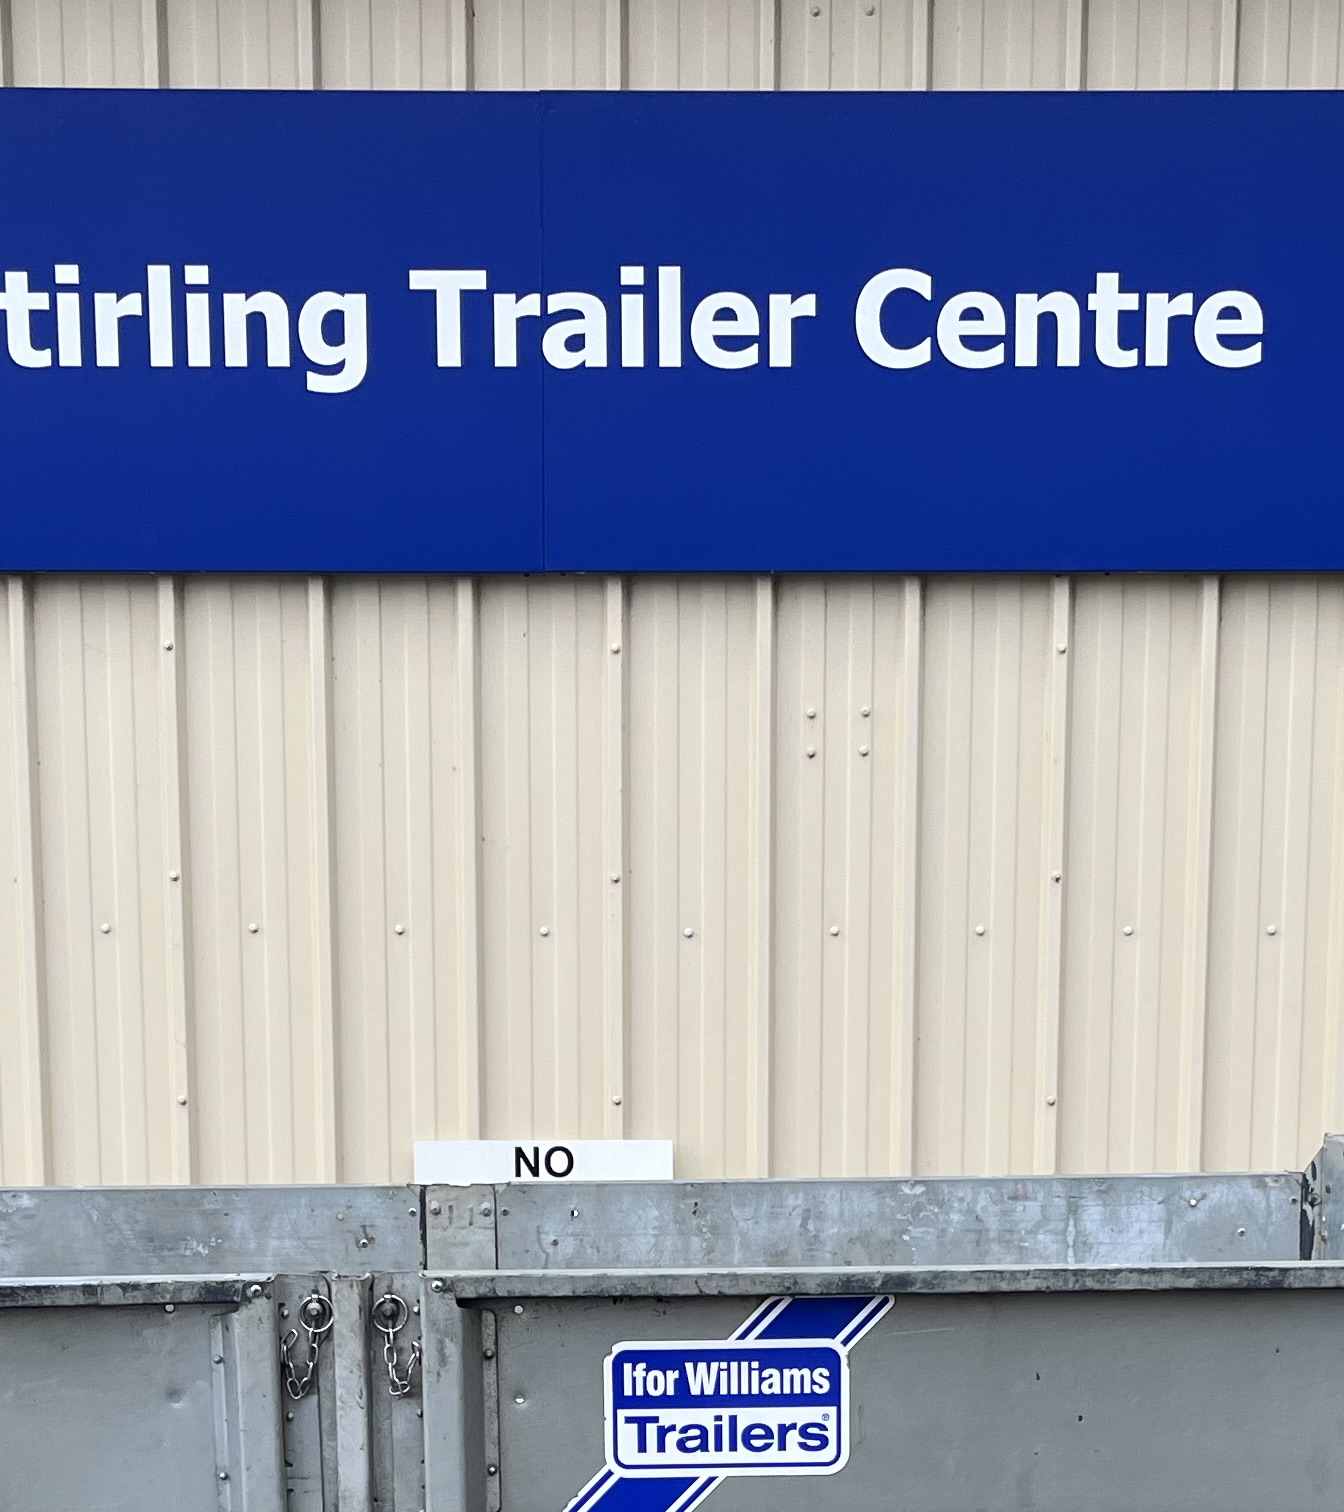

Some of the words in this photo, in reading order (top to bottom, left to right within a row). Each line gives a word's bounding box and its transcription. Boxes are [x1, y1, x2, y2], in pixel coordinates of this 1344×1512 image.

[408, 265, 817, 370] Trailer
[855, 267, 1265, 370] Centre
[514, 1145, 575, 1178] NO
[622, 1361, 680, 1397] Ifor
[684, 1360, 831, 1396] Williams
[624, 1413, 830, 1454] Trailers
